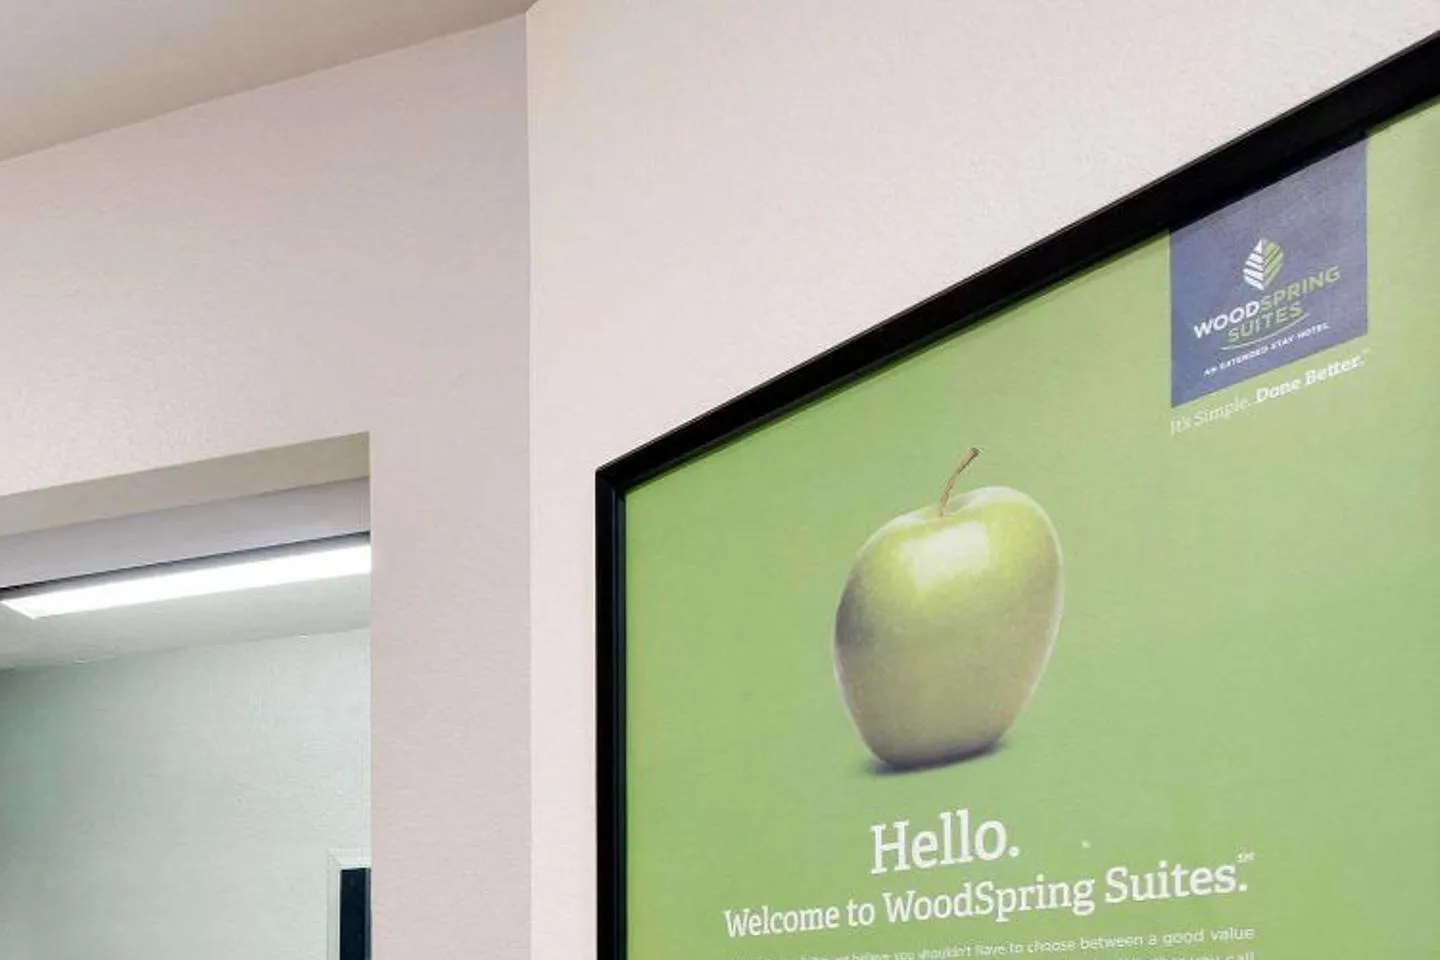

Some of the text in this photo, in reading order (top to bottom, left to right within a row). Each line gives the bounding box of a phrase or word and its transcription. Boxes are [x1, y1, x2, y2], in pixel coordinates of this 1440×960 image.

[1193, 265, 1342, 340] WOODSPRING
[1227, 301, 1305, 344] SUITES
[1270, 335, 1295, 350] STAY
[1297, 322, 1330, 339] HOTEL
[1255, 378, 1302, 403] Done
[1305, 354, 1366, 387] Better.
[870, 808, 1020, 874] Hello.
[724, 904, 840, 938] Welcome
[846, 898, 876, 928] to
[882, 873, 1096, 924] WoodSpring
[1009, 941, 1024, 953] to
[1027, 939, 1076, 953] choose
[1080, 935, 1144, 950] between
[1148, 934, 1158, 946] a
[1162, 929, 1205, 947] good
[1210, 926, 1255, 941] value
